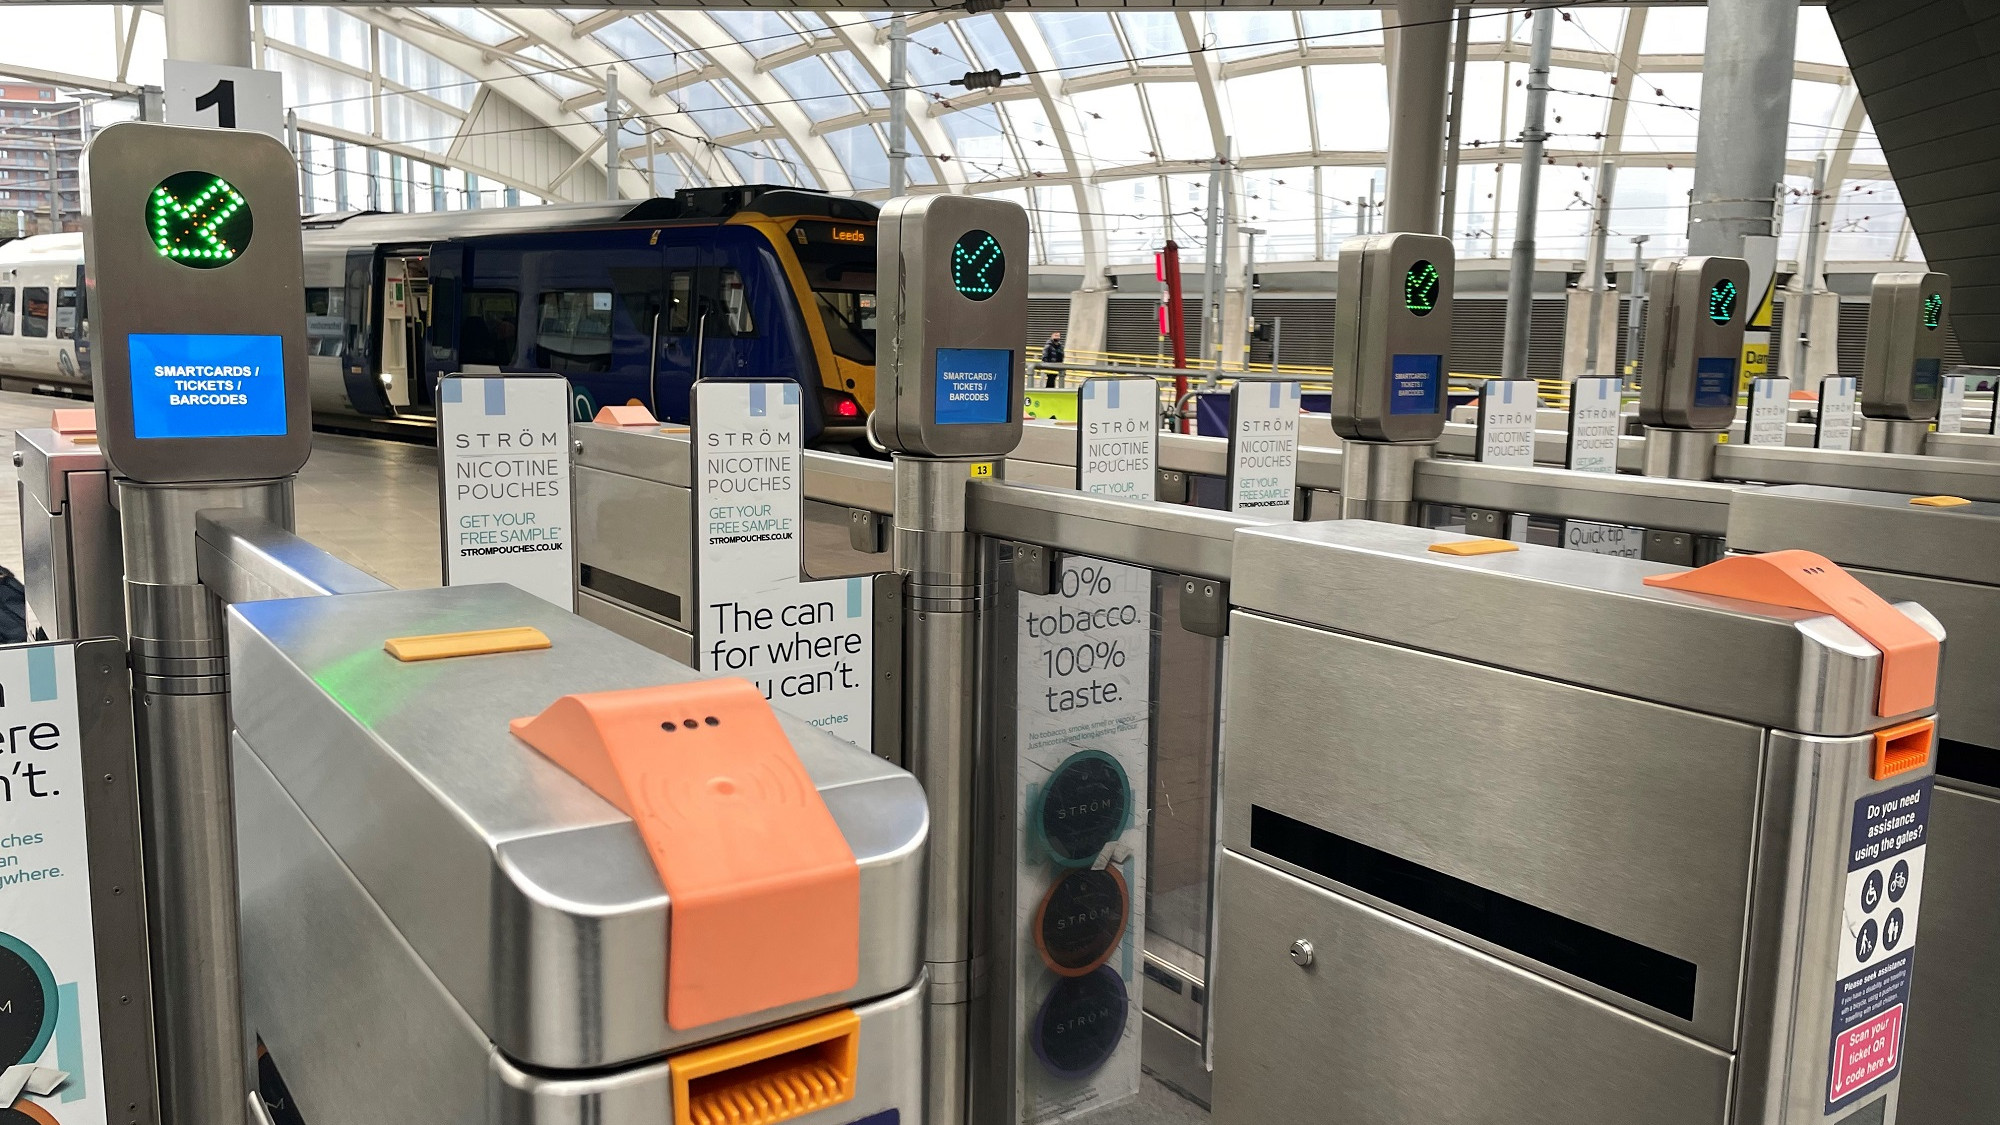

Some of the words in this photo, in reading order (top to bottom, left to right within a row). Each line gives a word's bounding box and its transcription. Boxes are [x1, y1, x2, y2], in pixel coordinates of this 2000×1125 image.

[195, 79, 236, 128] 1
[832, 227, 865, 242] Leeds
[154, 365, 252, 377] SMARTCARDS
[254, 366, 260, 377] /
[943, 372, 993, 381] SMARTCARDS
[175, 380, 234, 391] TICKETS
[237, 380, 242, 391] /
[953, 383, 983, 391] TICKETS
[170, 394, 248, 406] BARCODES
[949, 393, 989, 401] BARCODES
[1090, 418, 1149, 434] STRÖM
[1243, 418, 1293, 432] STRÖM
[1577, 426, 1615, 437] NICOTINE
[456, 429, 557, 448] STRÖM
[708, 429, 791, 447] STRÖM
[1488, 431, 1530, 443] NICOTINE
[1089, 441, 1149, 457] NICOTINE
[1241, 439, 1292, 453] NICOTINE
[1487, 445, 1530, 457] POUCHES
[456, 459, 559, 479] NICOTINE
[708, 456, 791, 475] NICOTINE
[1089, 457, 1149, 474] POUCHES
[1240, 455, 1292, 469] POUCHES
[977, 466, 987, 475] 13
[458, 481, 559, 500] POUCHES
[708, 476, 791, 494] POUCHES
[1109, 482, 1134, 493] YOUR
[1240, 478, 1256, 489] GET
[1257, 477, 1278, 488] YOUR
[1240, 491, 1261, 501] FREE
[709, 506, 735, 519] GET
[736, 505, 771, 517] YOUR
[460, 514, 490, 529] GET
[492, 512, 536, 527] YOUR
[709, 522, 741, 535] FREE
[460, 530, 497, 546] FREE
[709, 532, 793, 546] STROMPOUCHES.CO.UK
[1569, 526, 1605, 547] Quick
[460, 542, 563, 557] STROMPOUCHES.CO.UK
[1061, 566, 1112, 598] 0%
[710, 602, 773, 634] The
[781, 601, 834, 627] can
[1026, 605, 1141, 638] tobacco.
[710, 640, 760, 671] for
[767, 631, 862, 664] where
[1043, 640, 1126, 678] 100%
[781, 661, 860, 697] can't.
[1045, 679, 1123, 713] taste.
[1867, 805, 1880, 819] Do
[1881, 800, 1898, 818] you
[1900, 789, 1921, 808] need
[1868, 812, 1916, 838] assistance
[1855, 842, 1879, 861] using
[1881, 837, 1895, 852] the
[1895, 824, 1923, 850] gates?
[1844, 978, 1863, 993] Please
[1864, 970, 1877, 983] seek
[1877, 957, 1906, 977] assistance
[1849, 1028, 1870, 1047] Scan
[1870, 1018, 1889, 1039] your
[1849, 1044, 1871, 1066] ticket
[1872, 1036, 1886, 1053] QR
[1845, 1067, 1865, 1086] code
[1866, 1057, 1884, 1075] here
